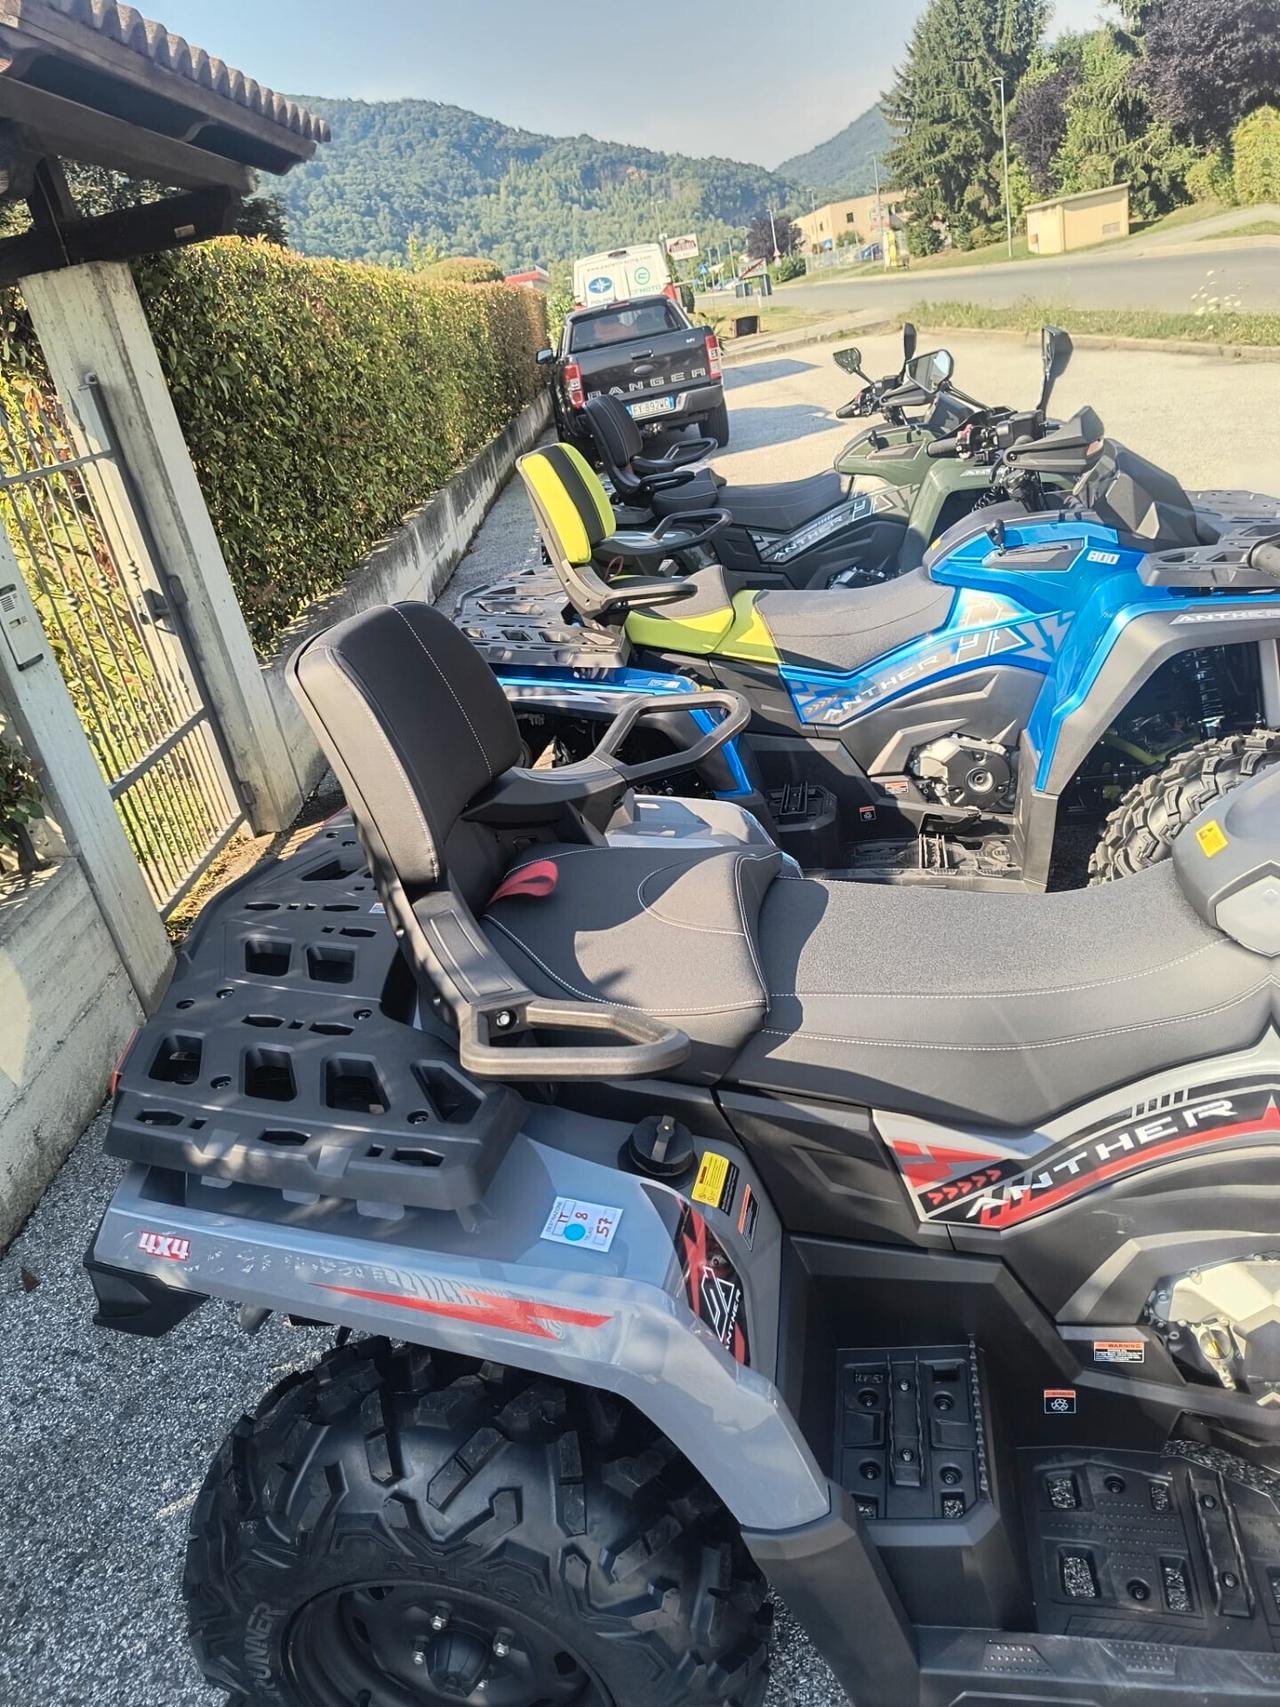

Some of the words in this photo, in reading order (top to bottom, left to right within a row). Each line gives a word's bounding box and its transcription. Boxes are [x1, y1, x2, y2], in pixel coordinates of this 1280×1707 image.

[587, 367, 706, 400] RANGER
[773, 514, 844, 561] ANTHER
[1086, 550, 1121, 565] 800
[823, 654, 941, 721] ANTHER
[966, 1098, 1238, 1219] ANTHER
[575, 1211, 588, 1221] 8
